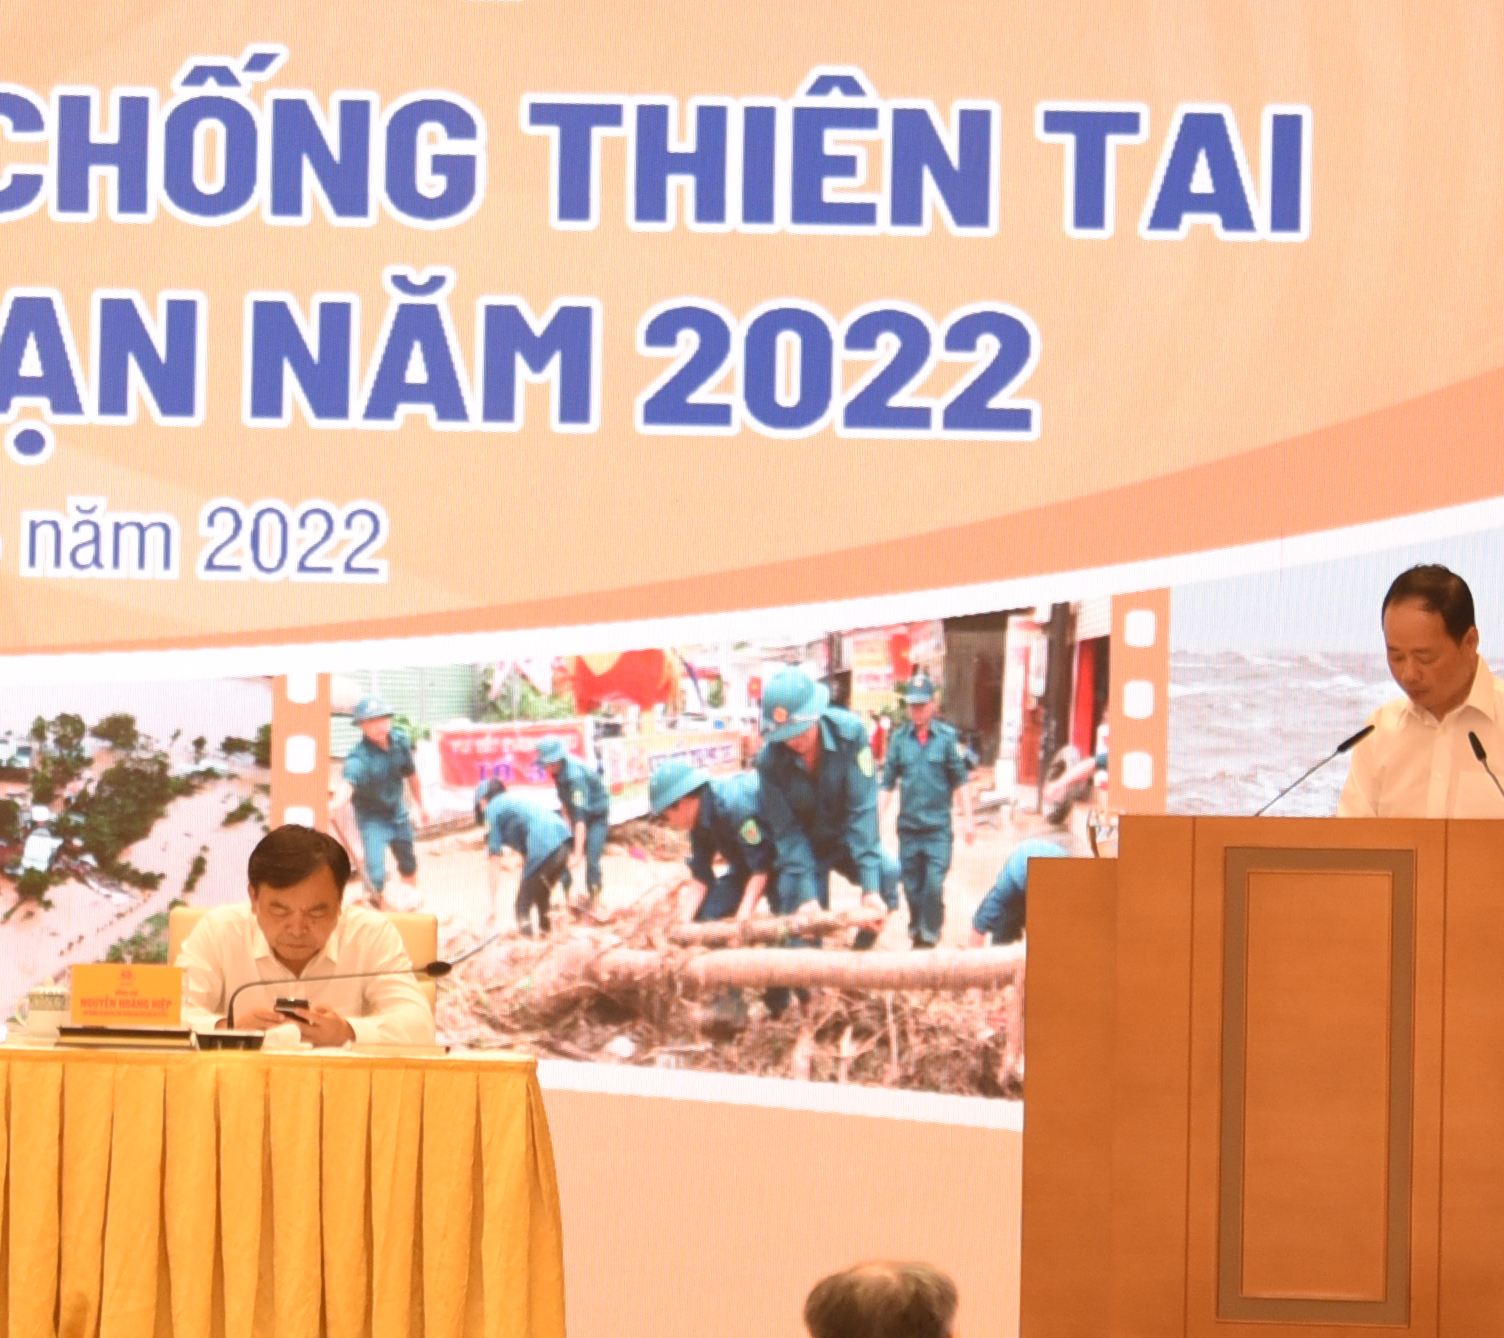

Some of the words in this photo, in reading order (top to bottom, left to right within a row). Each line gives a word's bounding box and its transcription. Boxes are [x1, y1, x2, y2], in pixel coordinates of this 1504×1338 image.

[529, 75, 991, 227] THIÊN
[1043, 110, 1303, 232] TAI
[251, 274, 592, 424] NĂM
[643, 305, 1032, 431] 2022
[27, 504, 172, 572] năm
[203, 505, 382, 575] 2022
